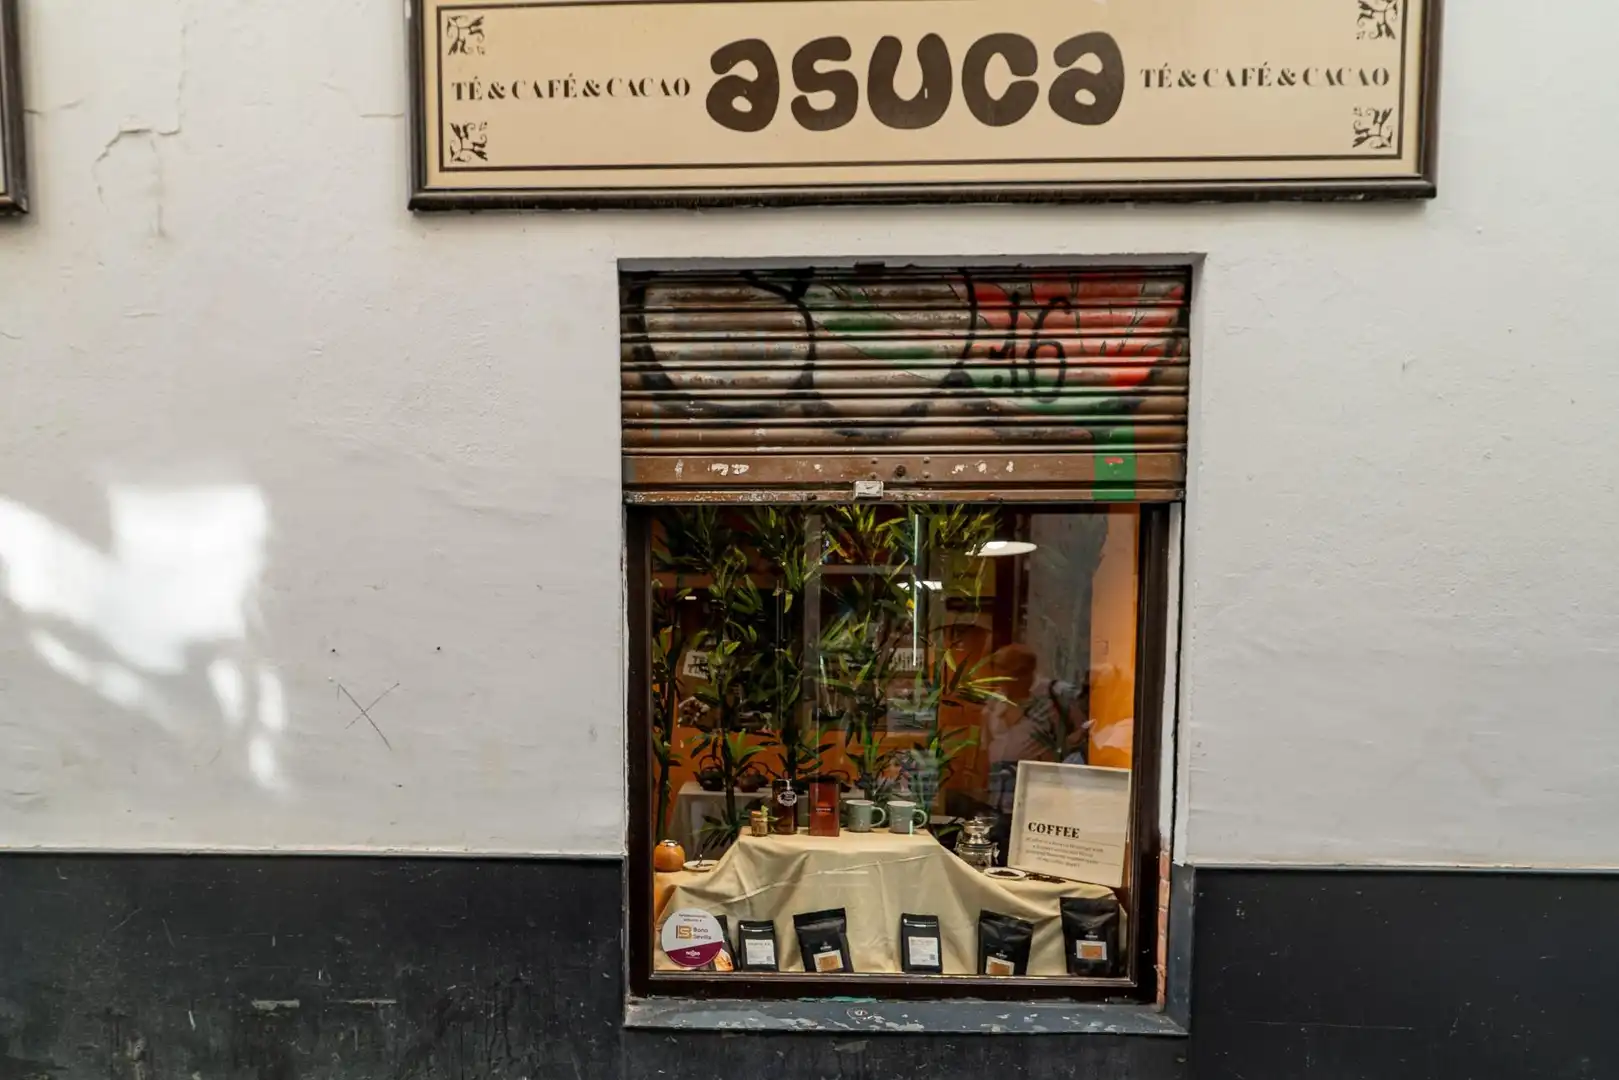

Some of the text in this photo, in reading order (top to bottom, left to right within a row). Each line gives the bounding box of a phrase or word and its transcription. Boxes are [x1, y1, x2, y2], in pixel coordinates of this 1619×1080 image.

[511, 73, 577, 99] CAFÉ
[606, 77, 691, 98] CACAO
[705, 31, 1125, 132] asuca
[1203, 61, 1272, 88] CAFÉ
[1303, 66, 1390, 87] CACAO
[1028, 822, 1081, 839] COFFEE
